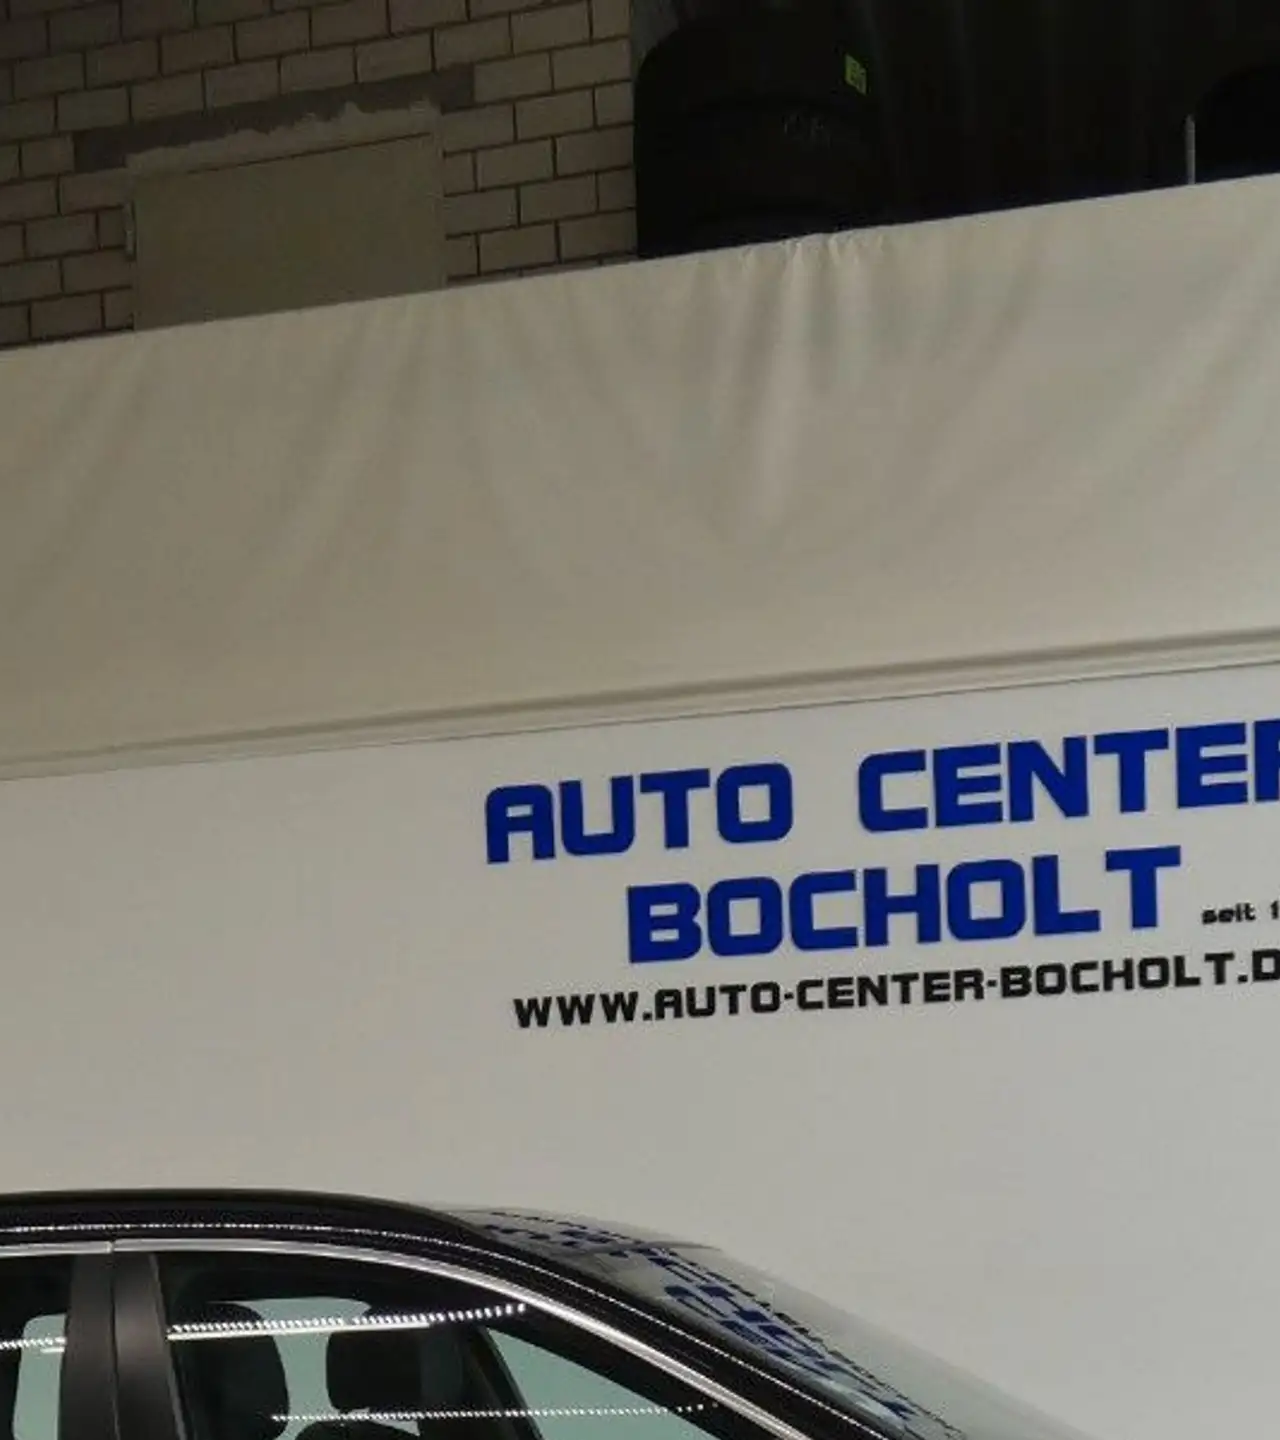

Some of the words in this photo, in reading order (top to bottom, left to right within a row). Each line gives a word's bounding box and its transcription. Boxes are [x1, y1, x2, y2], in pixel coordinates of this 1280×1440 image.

[486, 764, 793, 864] AUTO
[626, 846, 1182, 964] BOCHOLT
[1202, 902, 1256, 925] seit
